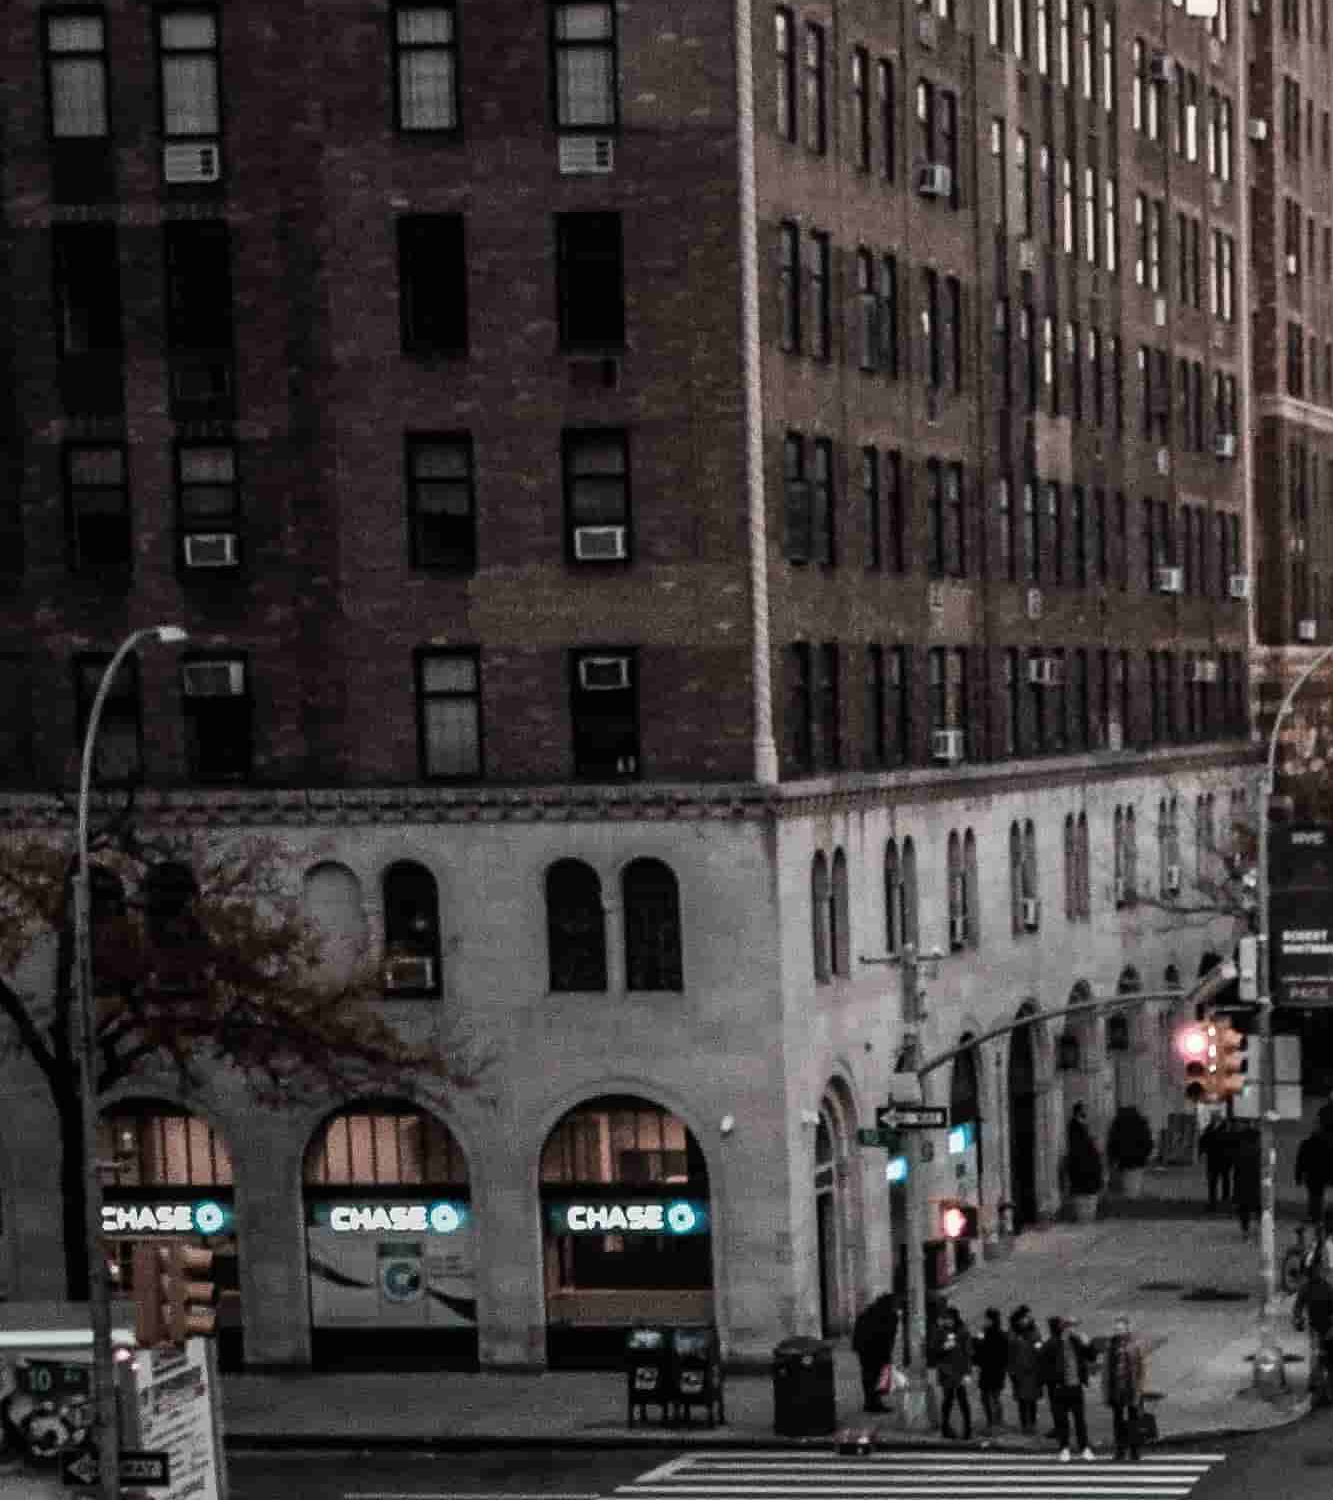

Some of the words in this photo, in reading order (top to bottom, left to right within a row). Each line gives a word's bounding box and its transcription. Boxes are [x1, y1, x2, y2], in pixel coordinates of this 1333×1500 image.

[101, 1206, 193, 1231] CHASE
[330, 1206, 427, 1231] CHASE
[567, 1205, 665, 1231] CHASE
[31, 1364, 51, 1393] 10
